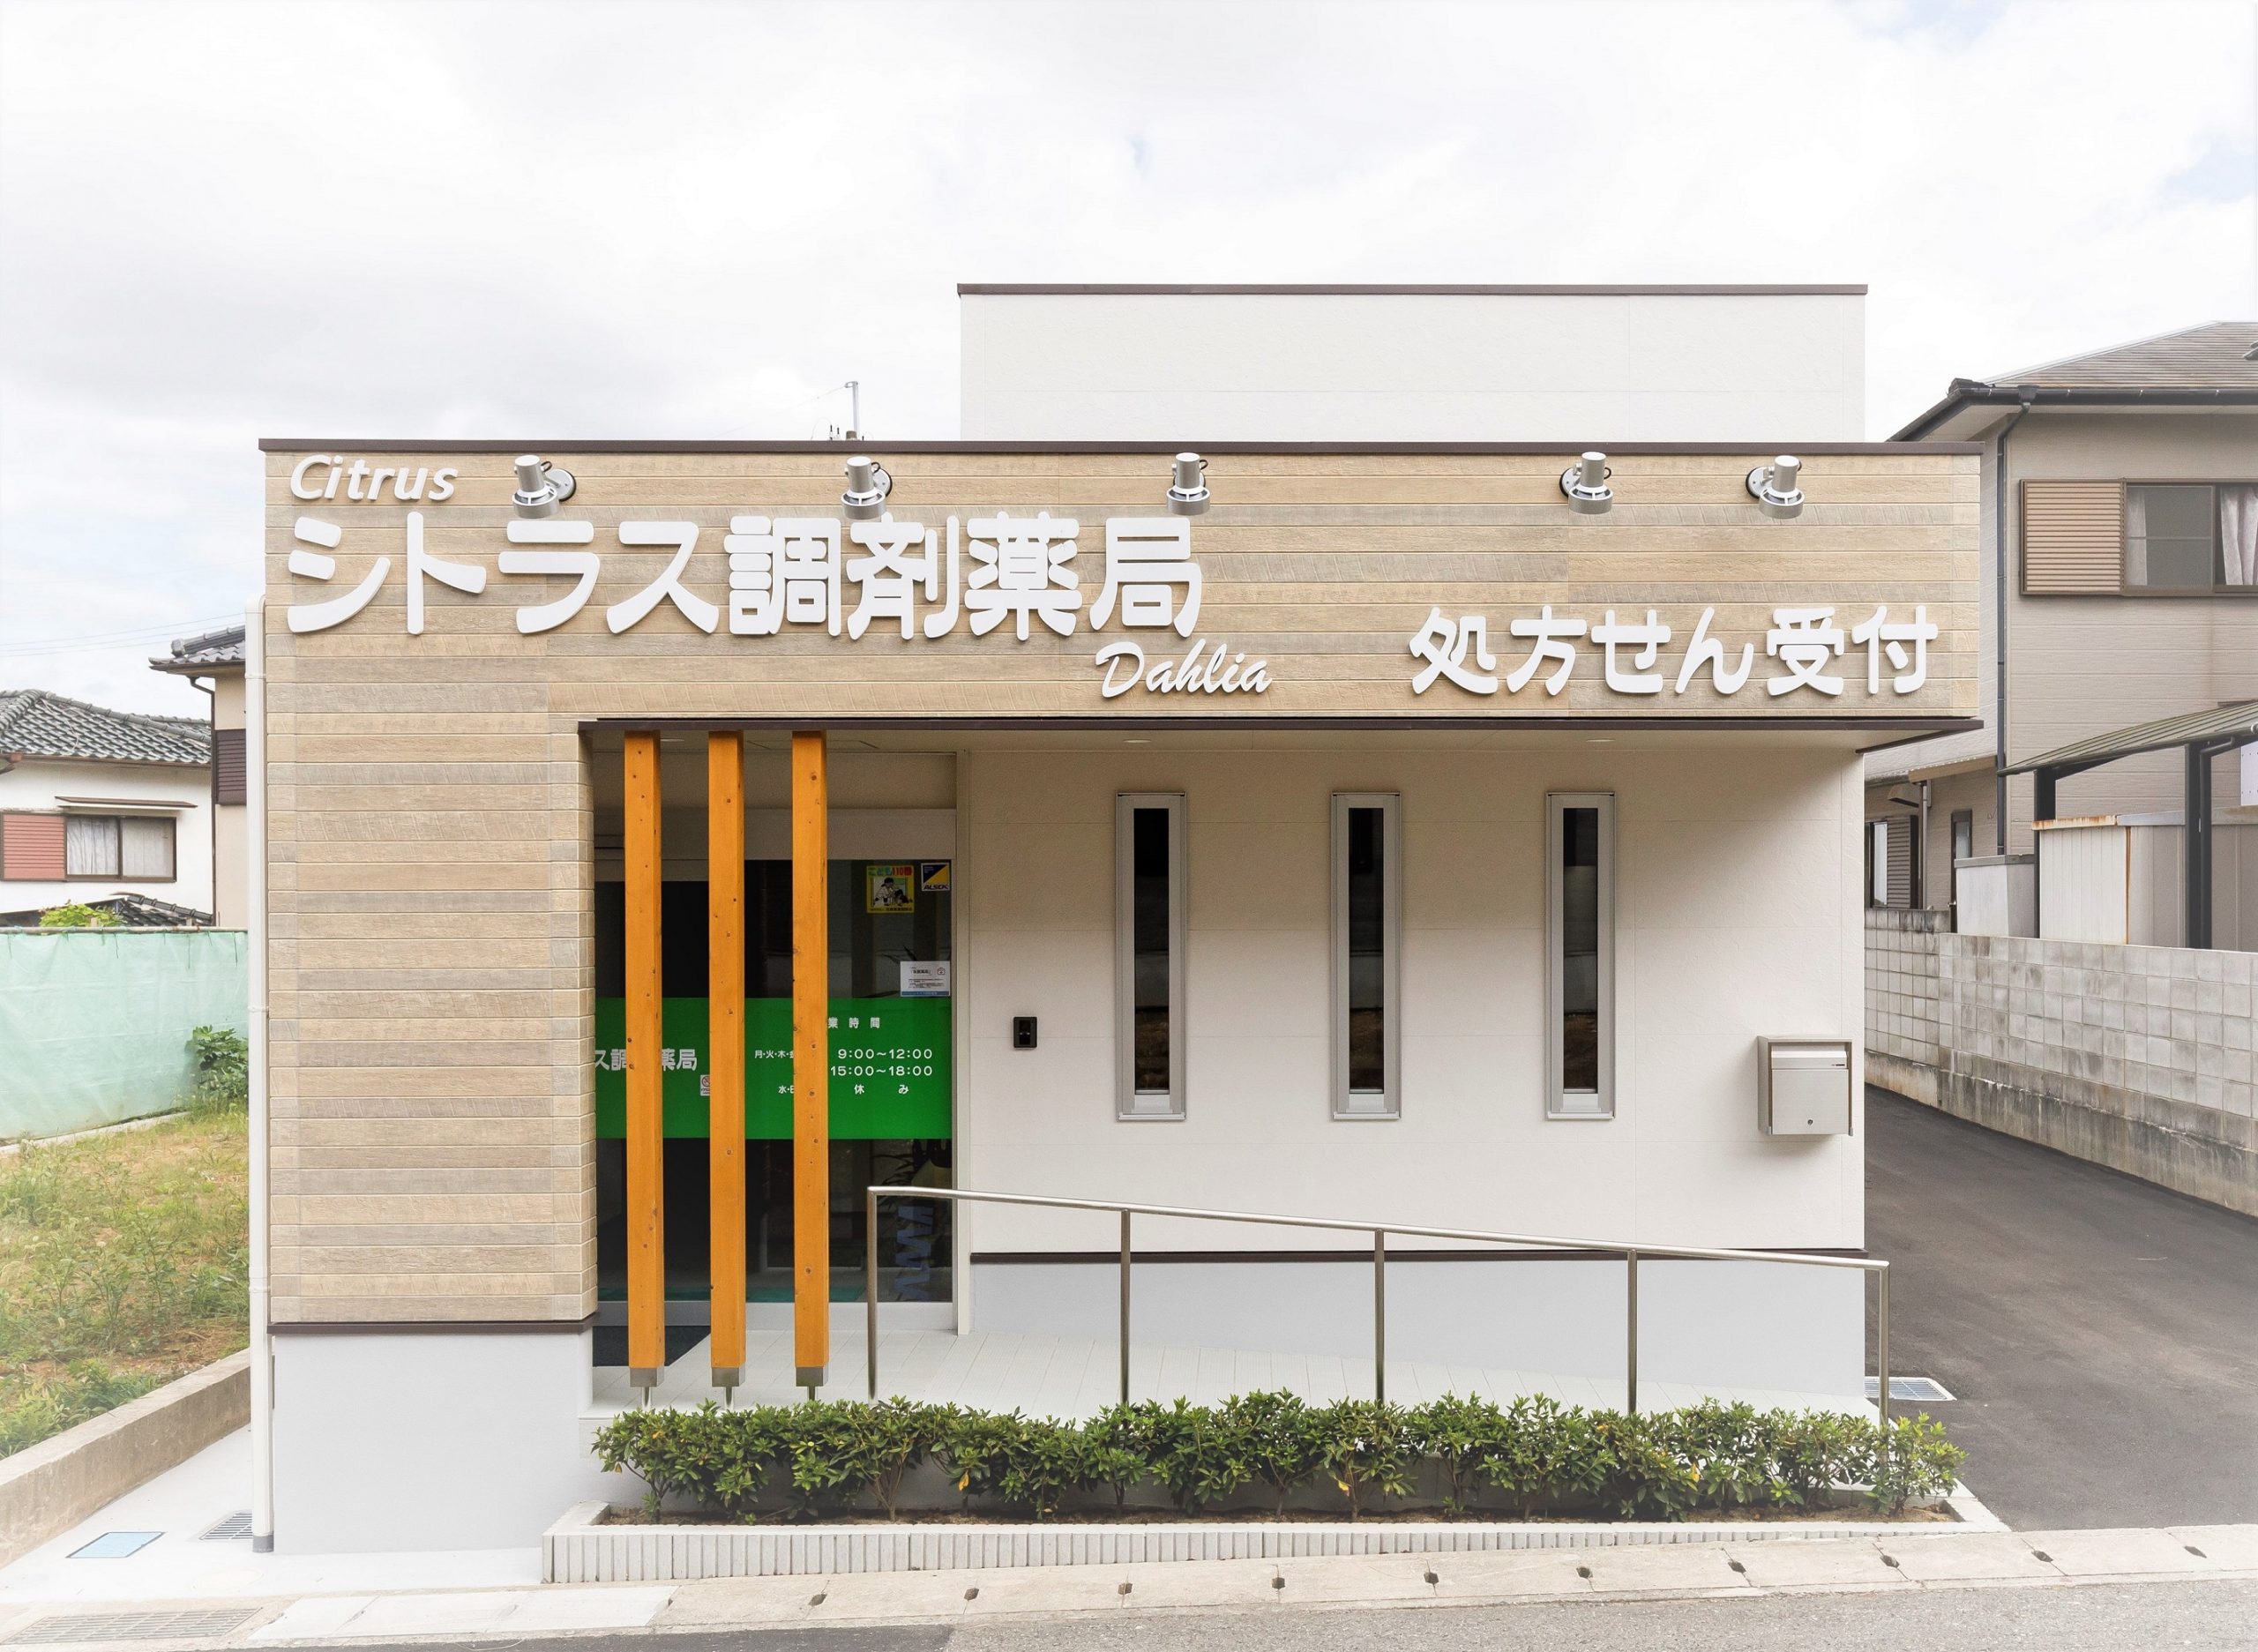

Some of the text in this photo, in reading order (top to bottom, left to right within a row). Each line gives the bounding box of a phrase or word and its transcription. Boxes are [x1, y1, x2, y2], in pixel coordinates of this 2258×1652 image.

[290, 453, 460, 502] Citrus
[288, 511, 1203, 641] シトラス調剤薬局
[1095, 638, 1274, 699] Dahlia
[1409, 605, 1939, 697] 処方せん受付
[827, 1017, 880, 1028] 業時間
[595, 1048, 698, 1071] ス調薬局
